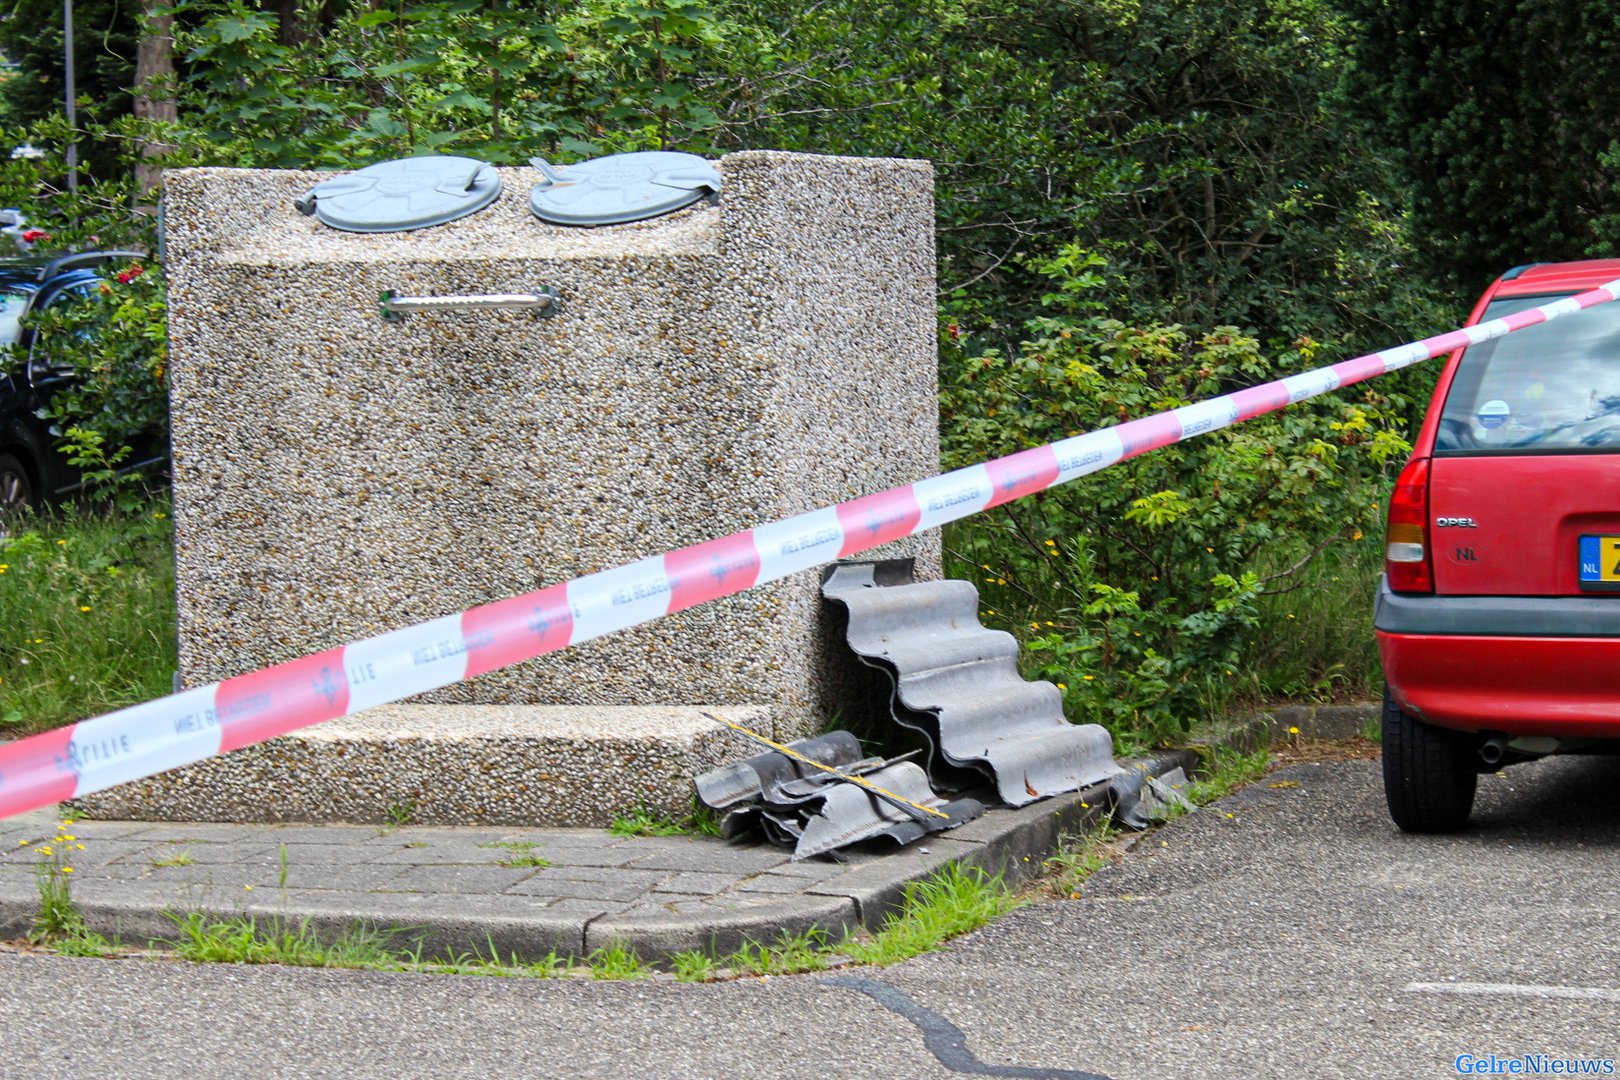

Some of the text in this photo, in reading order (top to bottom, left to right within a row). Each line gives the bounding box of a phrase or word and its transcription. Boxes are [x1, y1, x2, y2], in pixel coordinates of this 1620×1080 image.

[1436, 517, 1478, 528] OPEL
[1456, 547, 1478, 561] NL
[1583, 562, 1599, 574] NL
